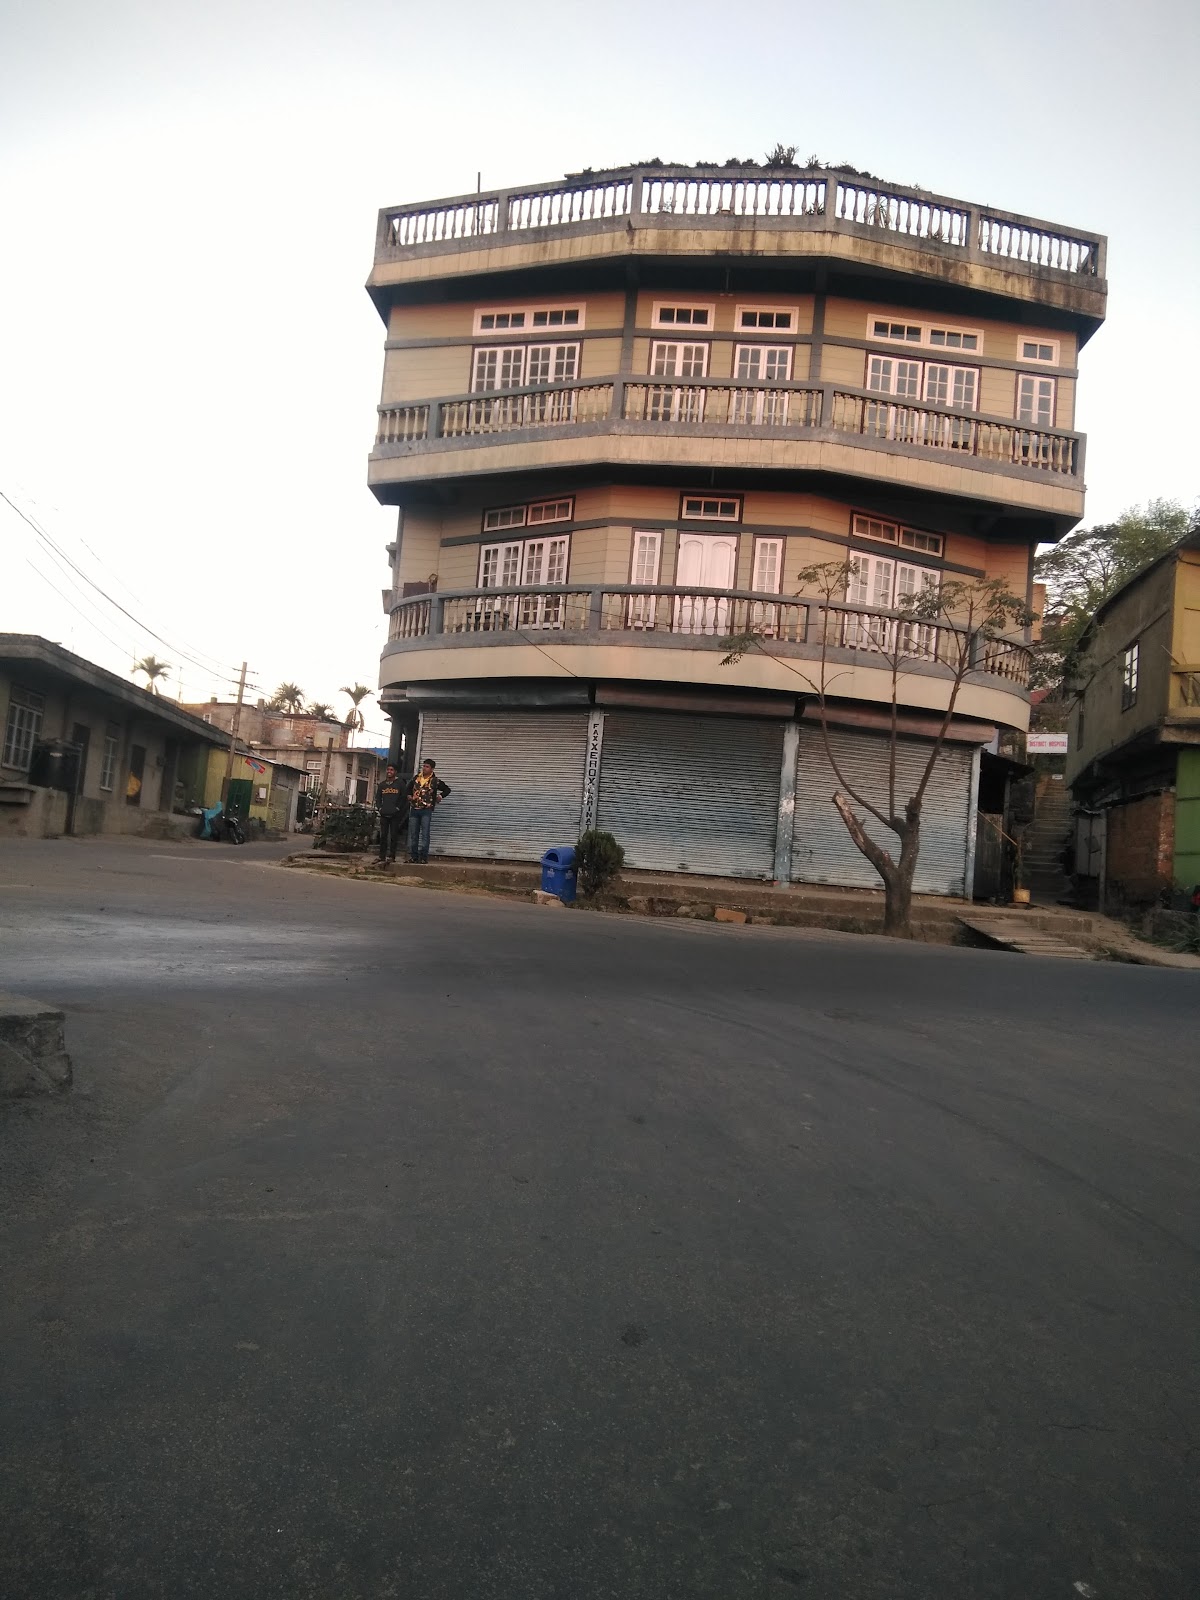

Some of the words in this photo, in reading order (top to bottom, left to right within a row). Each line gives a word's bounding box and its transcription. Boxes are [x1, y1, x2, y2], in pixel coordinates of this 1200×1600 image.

[592, 723, 600, 742] FAX
[588, 743, 598, 786] XEROX
[585, 787, 594, 830] LAMINAT
